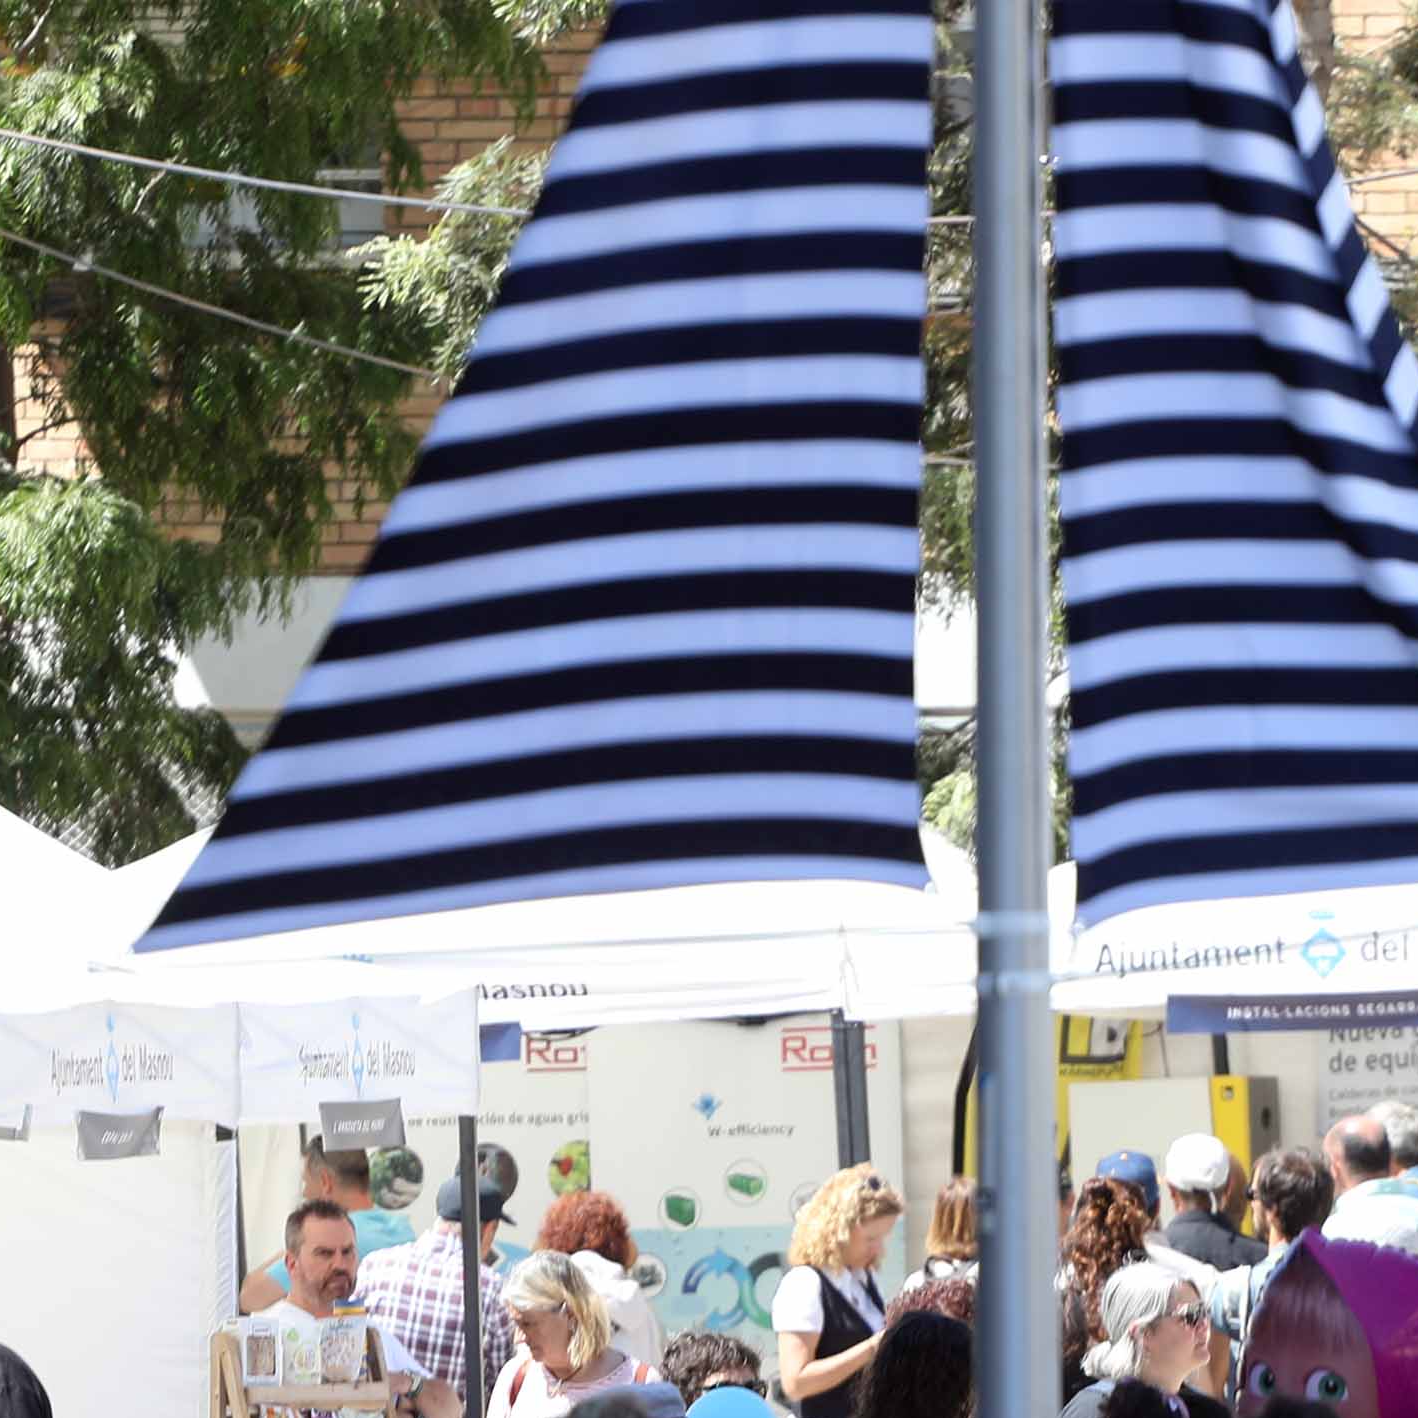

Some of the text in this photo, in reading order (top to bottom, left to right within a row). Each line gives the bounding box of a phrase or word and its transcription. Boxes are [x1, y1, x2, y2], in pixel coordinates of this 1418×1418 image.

[1095, 939, 1287, 979] Ajuntament
[1360, 930, 1409, 962] del
[366, 1039, 380, 1079] del
[382, 1039, 416, 1078] Masnou
[525, 1036, 587, 1065] Ro
[1328, 1050, 1357, 1073] de
[50, 1041, 175, 1097] Ajuntament del Masnou
[508, 1110, 523, 1124] de
[526, 1113, 564, 1129] aguas
